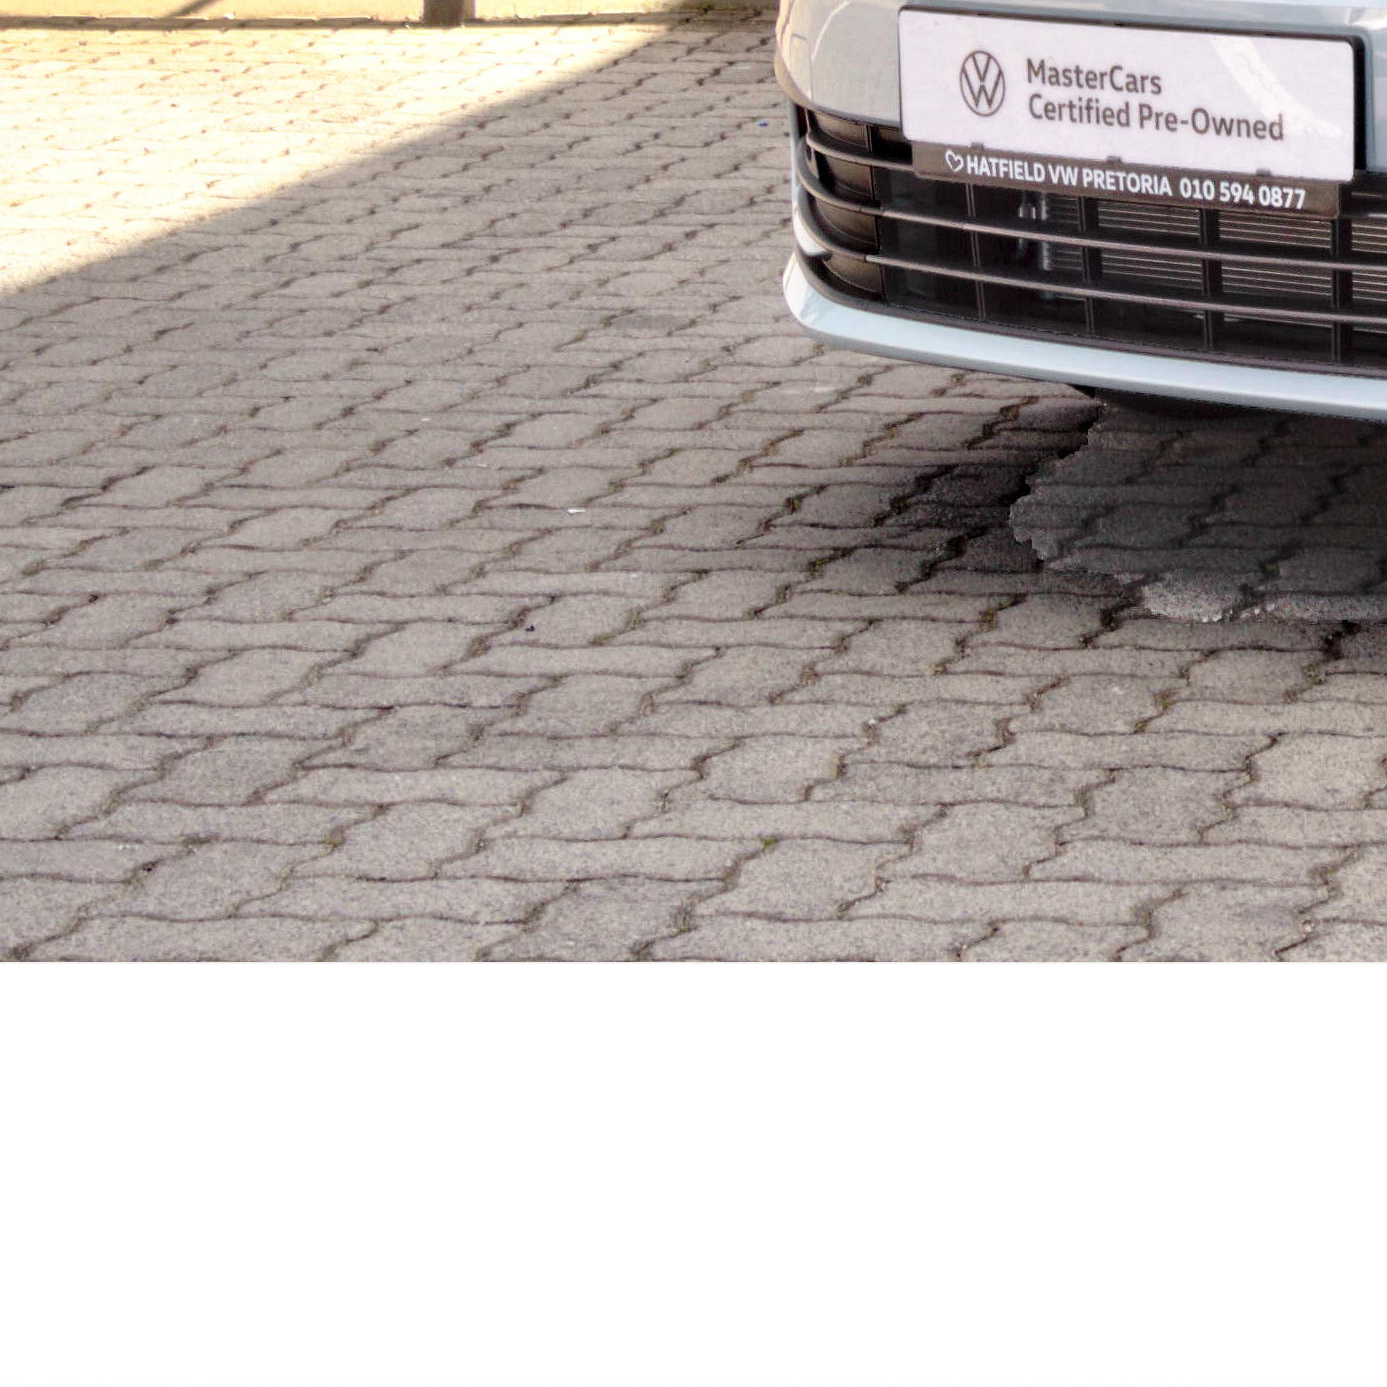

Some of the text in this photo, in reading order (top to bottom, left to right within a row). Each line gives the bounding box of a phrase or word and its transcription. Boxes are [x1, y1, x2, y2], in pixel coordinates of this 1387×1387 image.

[1026, 58, 1163, 95] MasterCars
[1027, 93, 1285, 141] Certified Pre-Owned
[966, 154, 1306, 210] HATFIELD VW PRETORIA 010 594 0877
